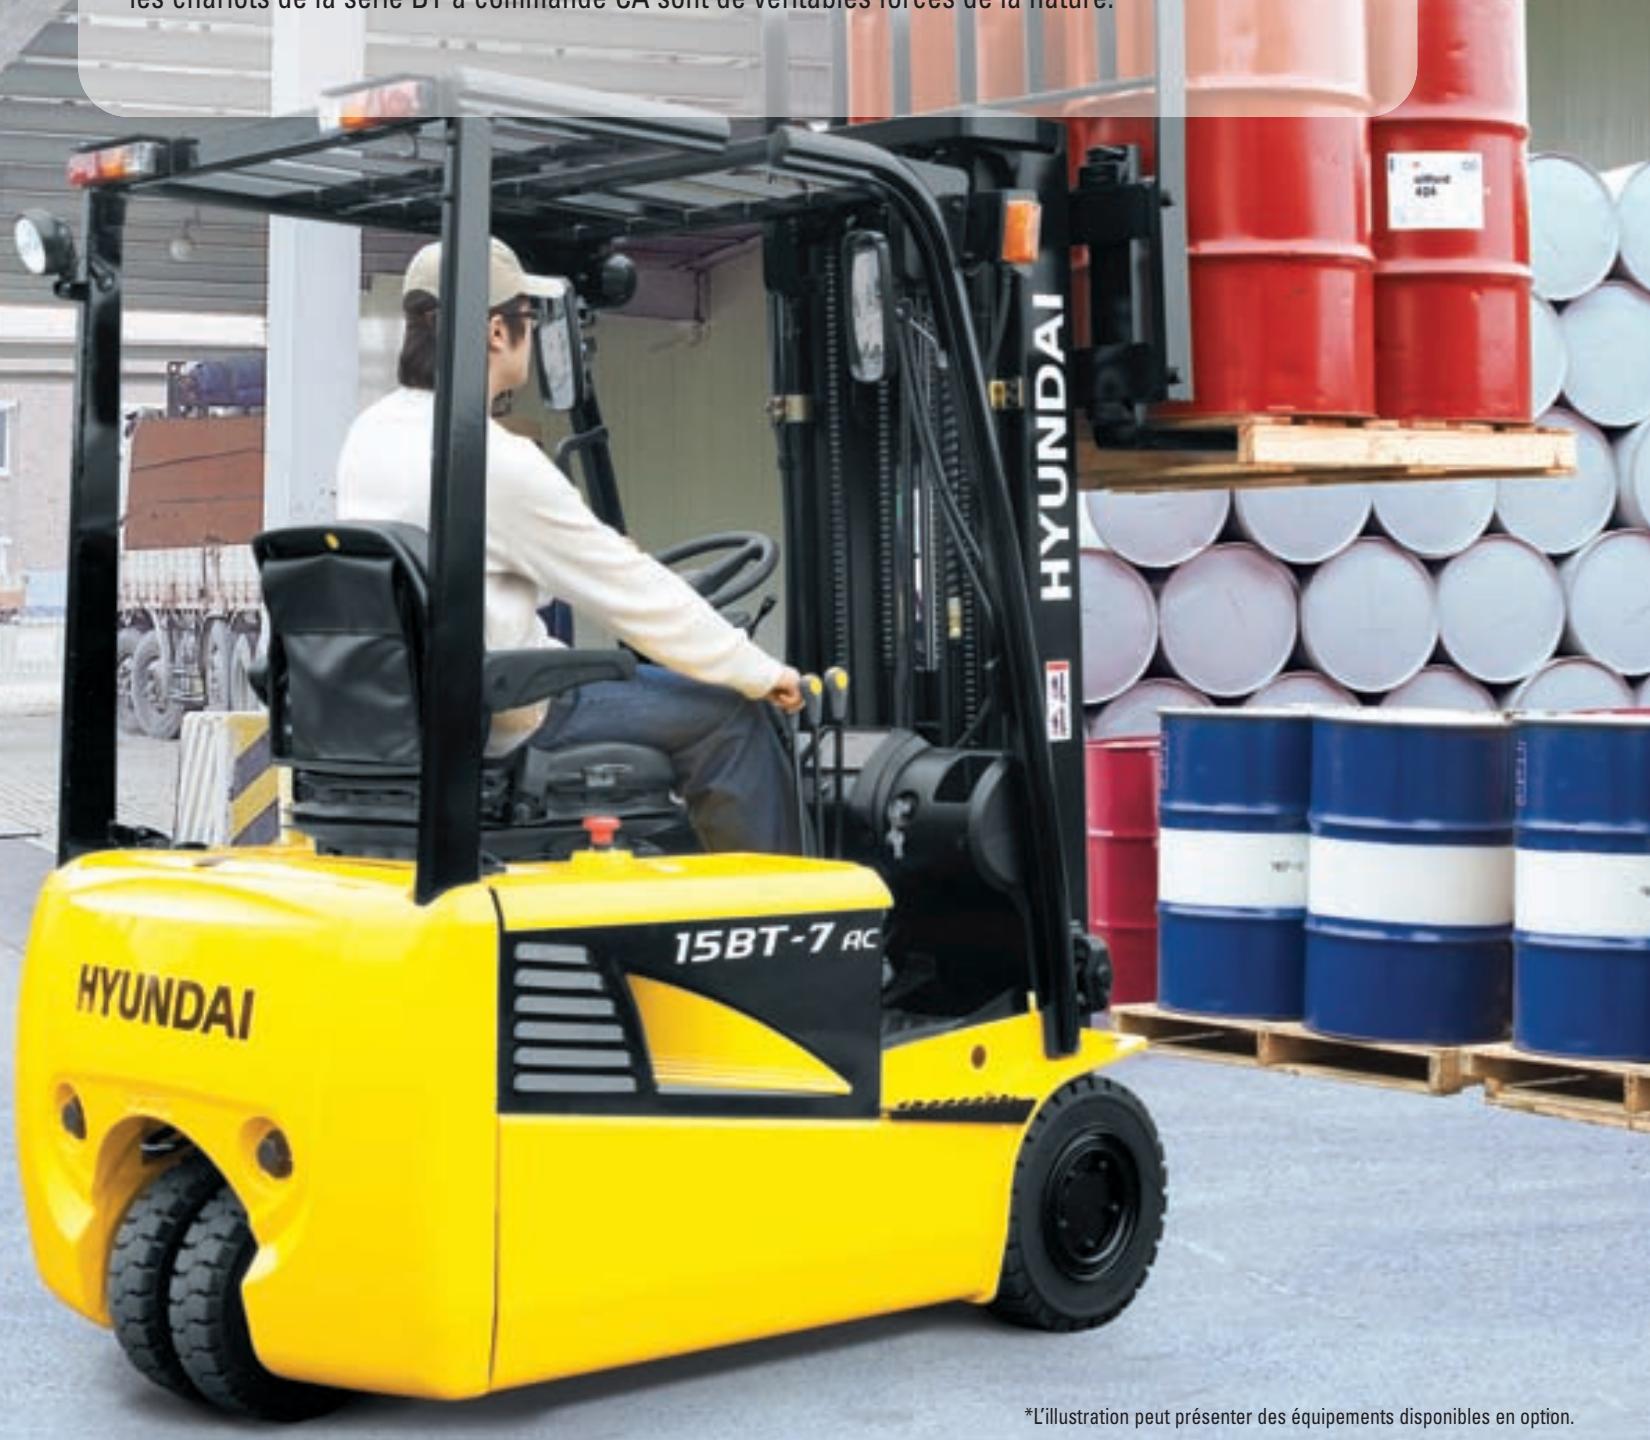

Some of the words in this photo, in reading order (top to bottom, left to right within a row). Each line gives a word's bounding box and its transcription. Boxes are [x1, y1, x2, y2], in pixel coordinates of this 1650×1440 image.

[1032, 294, 1072, 601] HYUNDAI
[674, 921, 836, 965] 15BT-7
[840, 927, 880, 951] AC
[77, 963, 255, 1041] HYUNDAI
